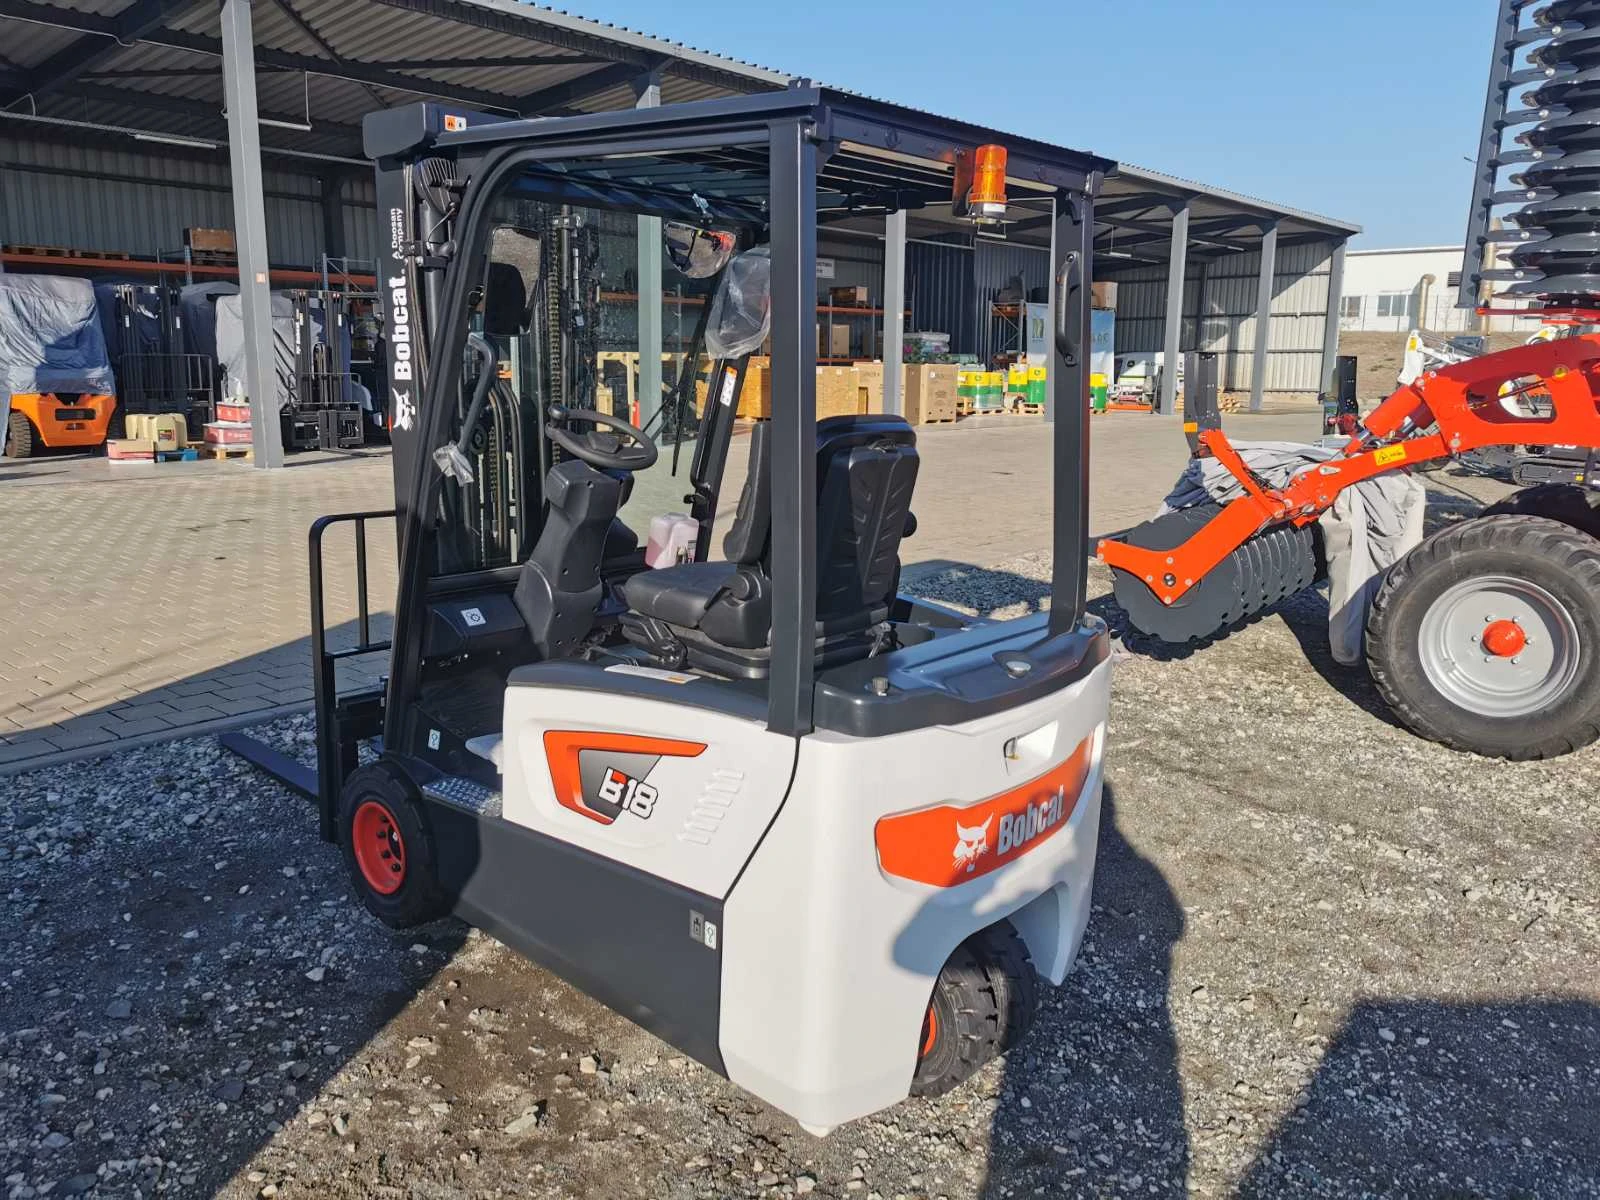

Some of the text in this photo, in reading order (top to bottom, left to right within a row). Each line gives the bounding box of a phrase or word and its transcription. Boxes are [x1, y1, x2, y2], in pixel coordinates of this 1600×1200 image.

[392, 251, 400, 259] A
[388, 276, 412, 380] Bobcat
[598, 766, 659, 819] B18
[997, 784, 1065, 856] Bobcat
